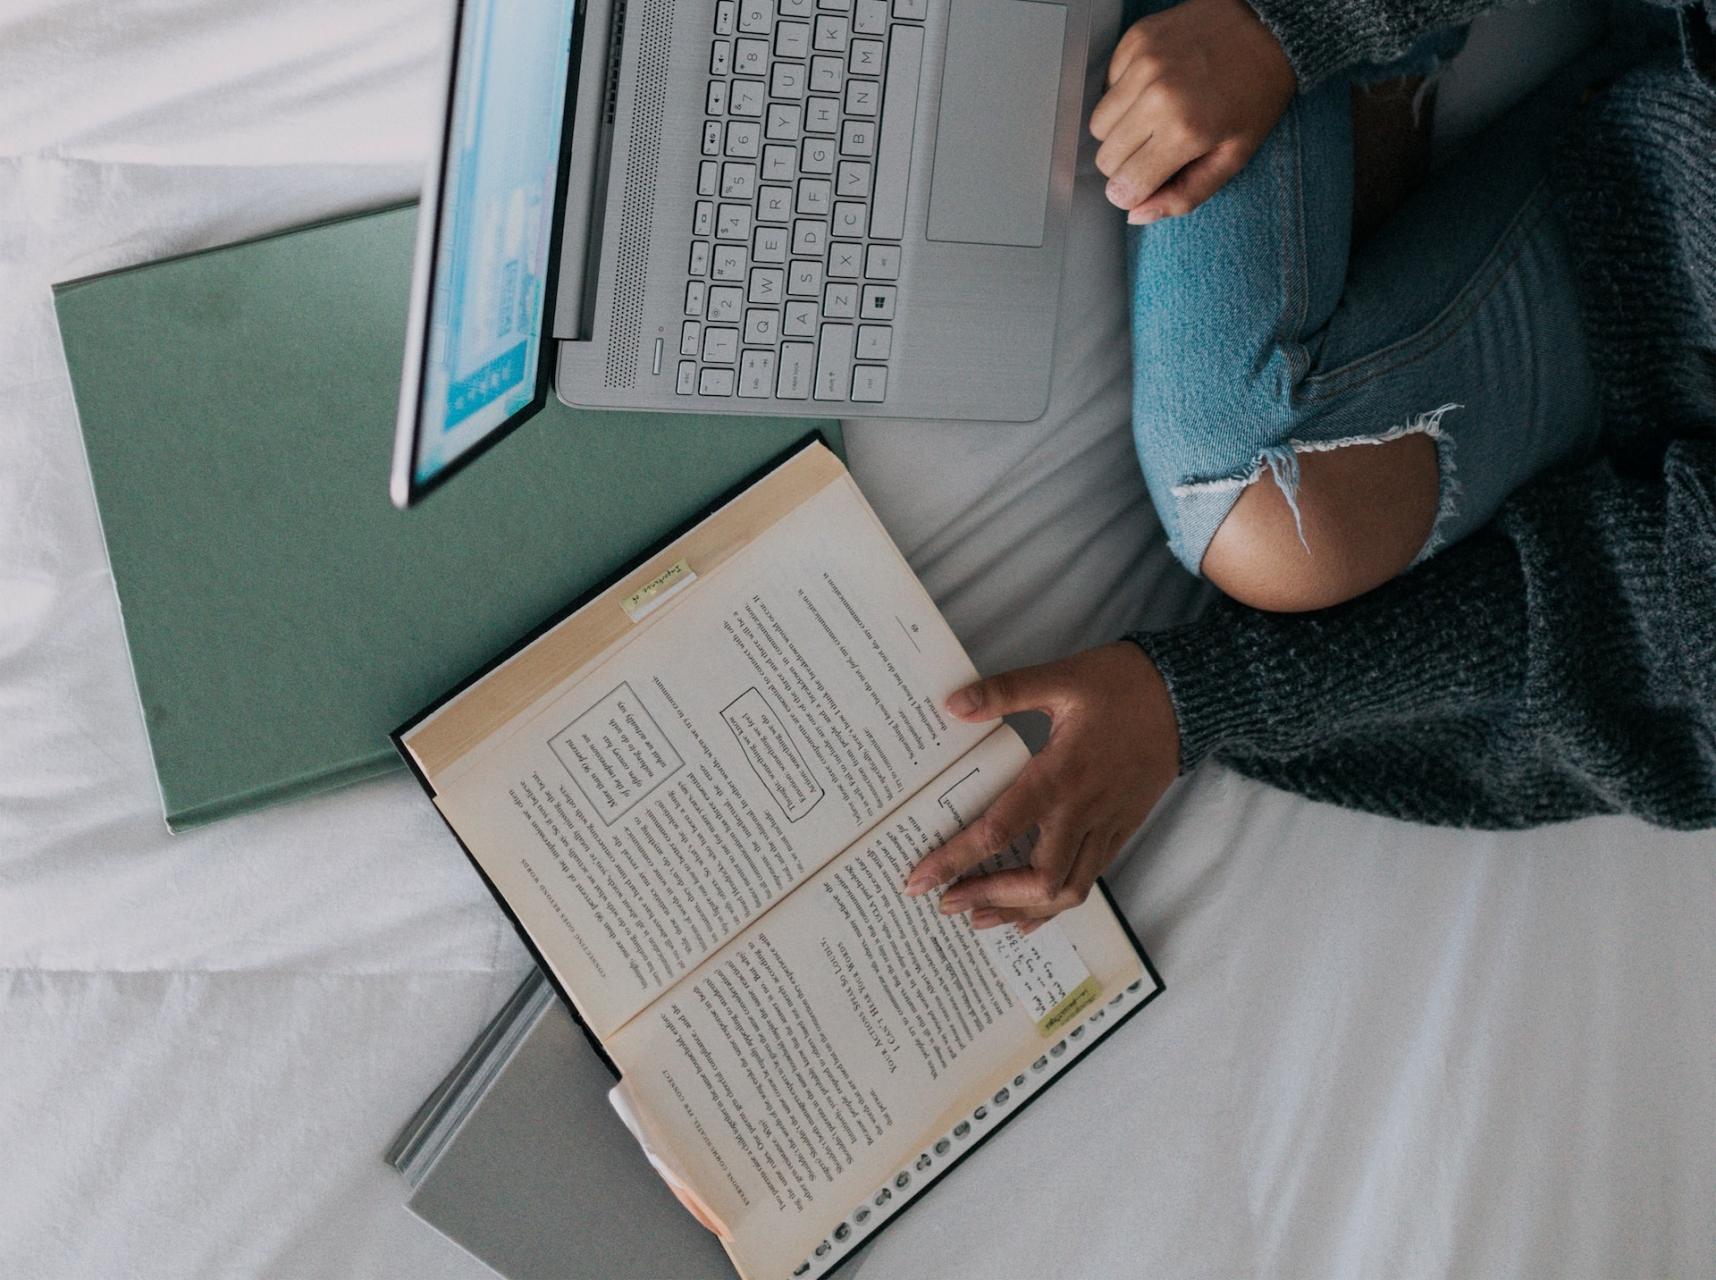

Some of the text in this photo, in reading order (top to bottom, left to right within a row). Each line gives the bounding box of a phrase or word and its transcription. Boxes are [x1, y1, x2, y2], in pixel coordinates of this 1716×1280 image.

[751, 11, 762, 20] 9
[826, 28, 837, 39] K
[746, 52, 757, 61] 8
[861, 51, 872, 63] M
[822, 69, 833, 77] J
[782, 75, 794, 86] U
[742, 93, 752, 102] 7
[857, 92, 869, 103] N
[817, 109, 829, 120] H
[778, 116, 790, 127] Y
[737, 135, 748, 144] 6
[853, 133, 864, 143] B
[812, 150, 825, 161] G
[773, 158, 785, 168] T
[733, 176, 744, 184] 5
[849, 173, 860, 185] V
[808, 192, 820, 201] F
[769, 198, 781, 209] R
[729, 218, 739, 226] 4
[844, 214, 856, 225] C
[804, 231, 816, 242] D
[765, 240, 777, 249] E
[725, 258, 736, 267] 3
[840, 255, 851, 265] X
[800, 273, 812, 282] S
[760, 277, 773, 294] W
[720, 299, 731, 307] 2
[835, 295, 847, 305] Z
[795, 312, 808, 324] A
[756, 320, 769, 333] Q
[910, 623, 919, 633] 49
[741, 712, 755, 727] feel
[760, 714, 770, 725] do
[625, 713, 647, 740] actually
[729, 716, 744, 736] know
[753, 727, 761, 736] we
[768, 724, 776, 734] we
[644, 741, 654, 750] we
[743, 736, 751, 745] we
[608, 718, 654, 778] nothing to do with
[760, 735, 786, 772] something
[774, 733, 801, 770] something
[600, 734, 642, 788] often convey has
[650, 749, 666, 769] what
[749, 743, 775, 780] something
[581, 732, 631, 798] of the impression we
[564, 738, 616, 808] More than 90 percent
[521, 858, 606, 977] CONNECTING GOES BEYOND WORDS
[1025, 958, 1035, 973] say
[1012, 958, 1046, 1016] What we say
[1053, 981, 1066, 998] What
[662, 1070, 685, 1102] CONNECT
[684, 1103, 694, 1117] FEW
[726, 1172, 750, 1206] EVERYONE
